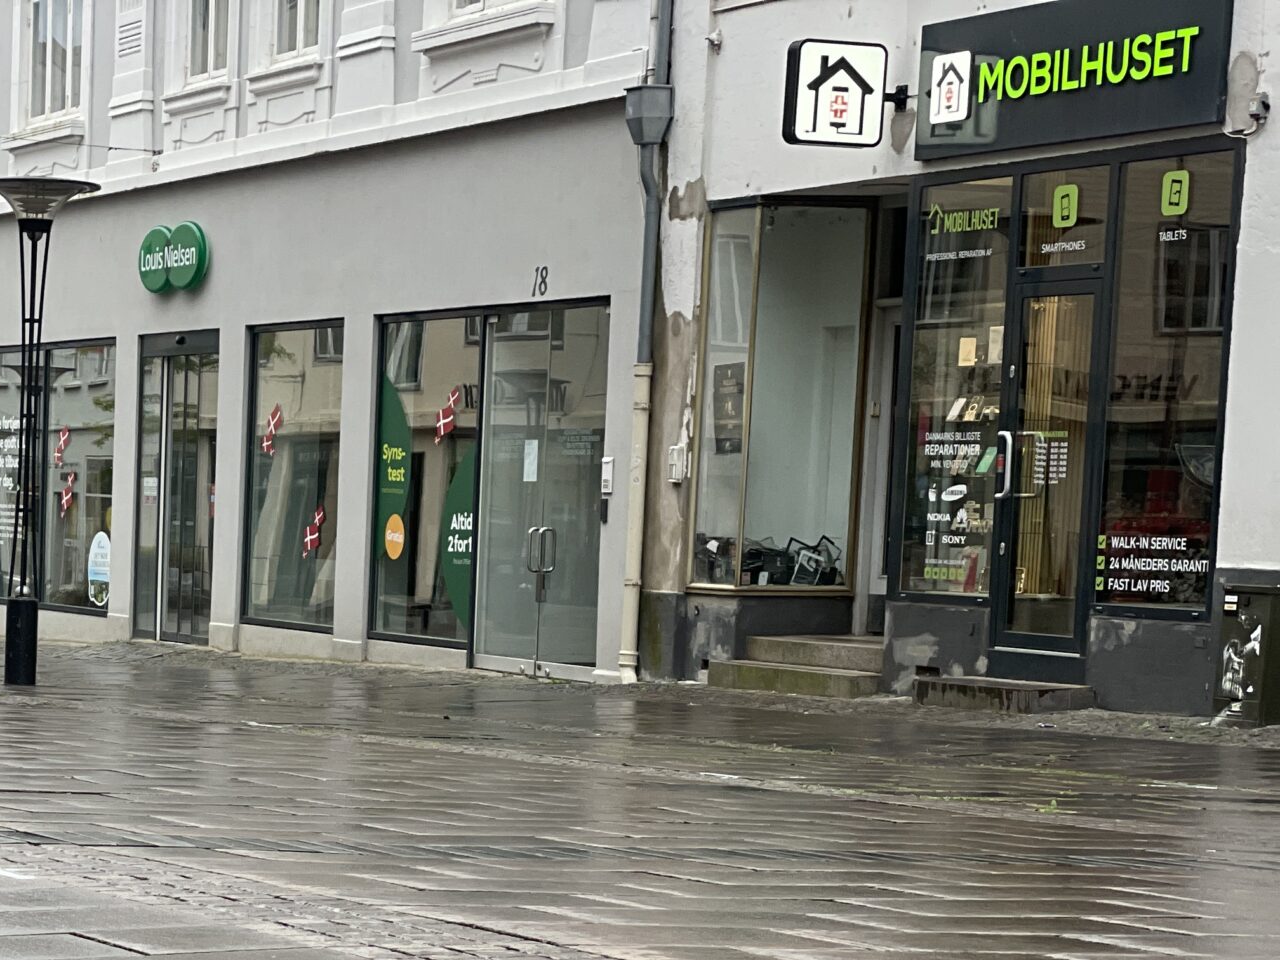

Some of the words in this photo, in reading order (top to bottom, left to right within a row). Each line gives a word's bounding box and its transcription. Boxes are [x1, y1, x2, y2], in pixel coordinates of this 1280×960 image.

[977, 26, 1200, 104] MOBILHUSET
[944, 208, 1000, 233] MOBILHUSET
[1159, 229, 1187, 242] TABLETS
[1041, 240, 1086, 254] SMARTPHONES
[141, 246, 164, 272] Louis
[164, 243, 196, 268] Nielsen
[531, 265, 549, 298] 18
[2, 415, 26, 432] fortjenr
[925, 431, 955, 441] DANMARKS
[955, 431, 981, 440] BILLIGSTE
[382, 443, 406, 463] Syns-
[924, 443, 981, 456] REPARATIONER
[387, 465, 406, 482] test
[450, 511, 474, 531] Altid
[926, 513, 951, 522] NOKIA
[941, 534, 967, 545] SONY
[1111, 536, 1149, 550] WALK-IN
[1150, 537, 1187, 550] SERVICE
[1109, 556, 1120, 570] 24
[1121, 553, 1169, 571] MÅNEDERS
[1170, 559, 1209, 573] GARANTI
[1107, 577, 1130, 591] FAST
[1130, 579, 1149, 592] LAV
[1149, 580, 1170, 593] PRIS
